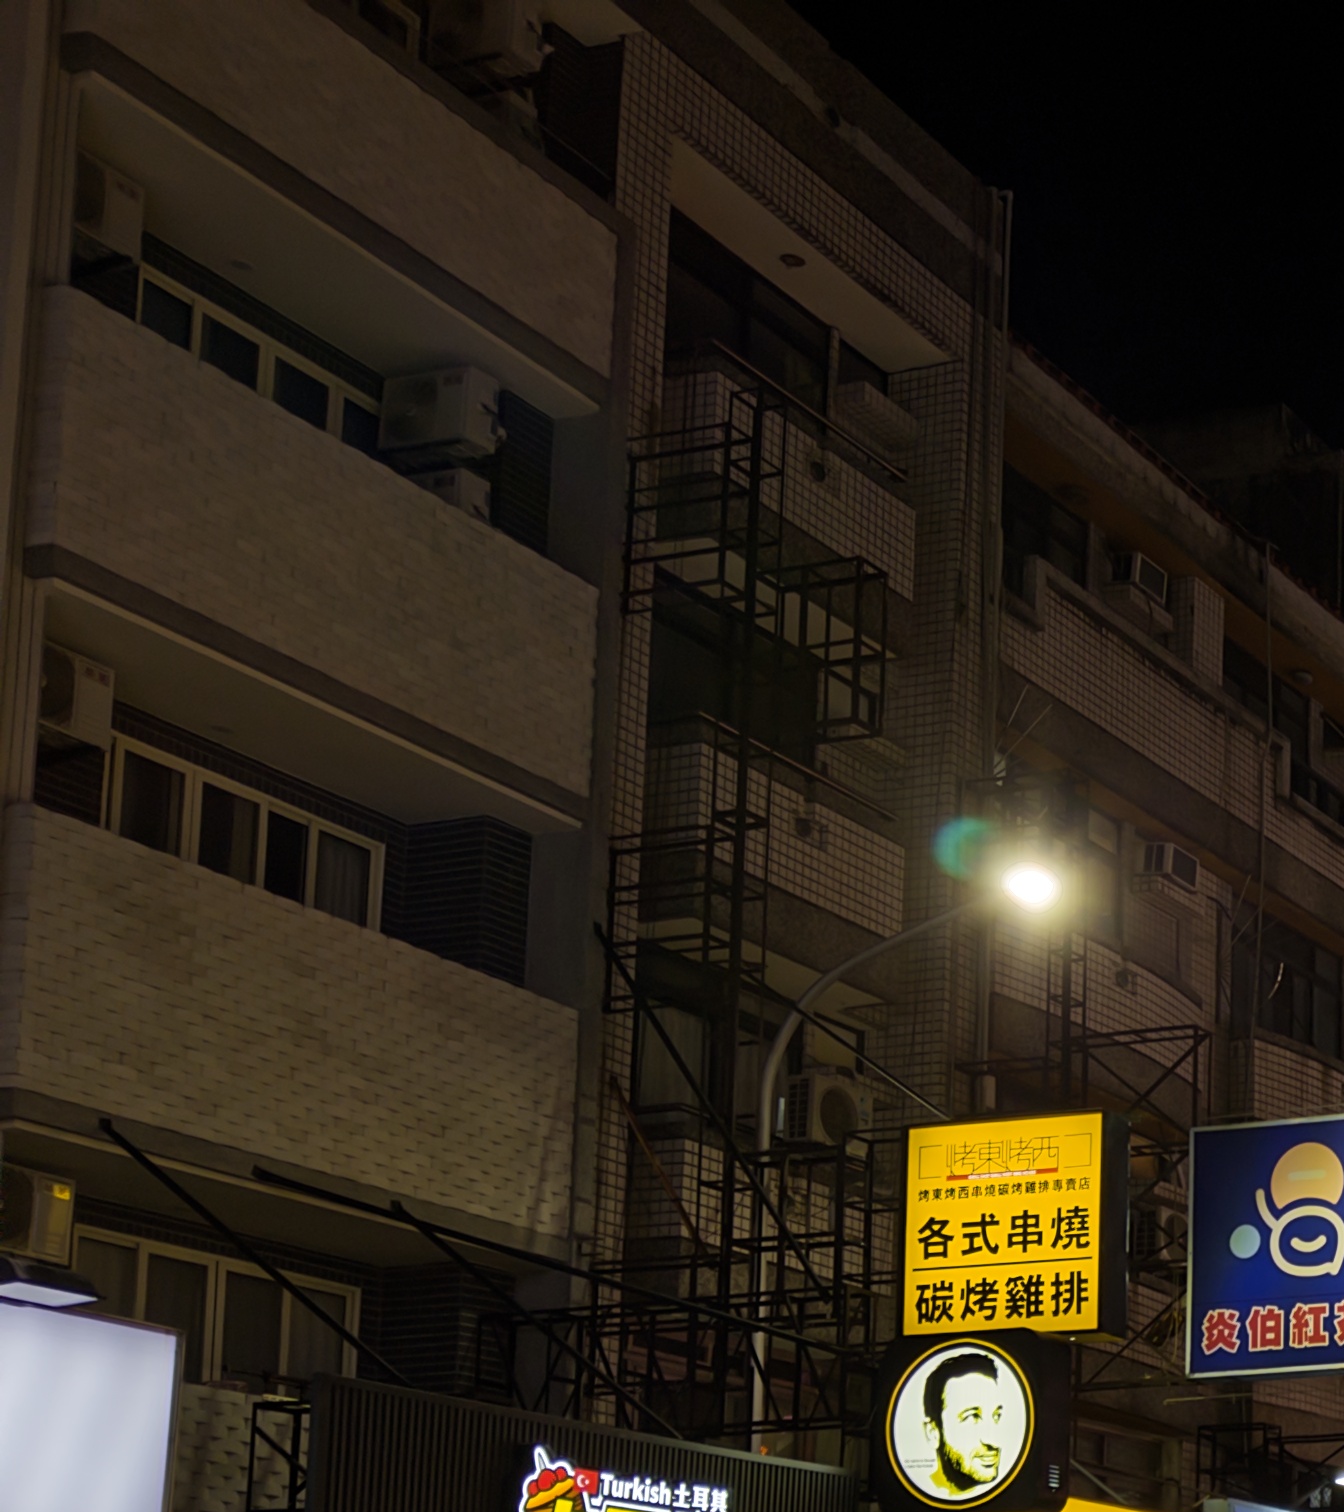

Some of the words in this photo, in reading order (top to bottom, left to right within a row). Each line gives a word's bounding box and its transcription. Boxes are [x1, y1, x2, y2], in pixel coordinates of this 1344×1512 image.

[917, 1205, 1091, 1260] 各式串燒
[915, 1270, 1089, 1324] 碳烤雞排
[601, 1473, 672, 1506] Turkish
